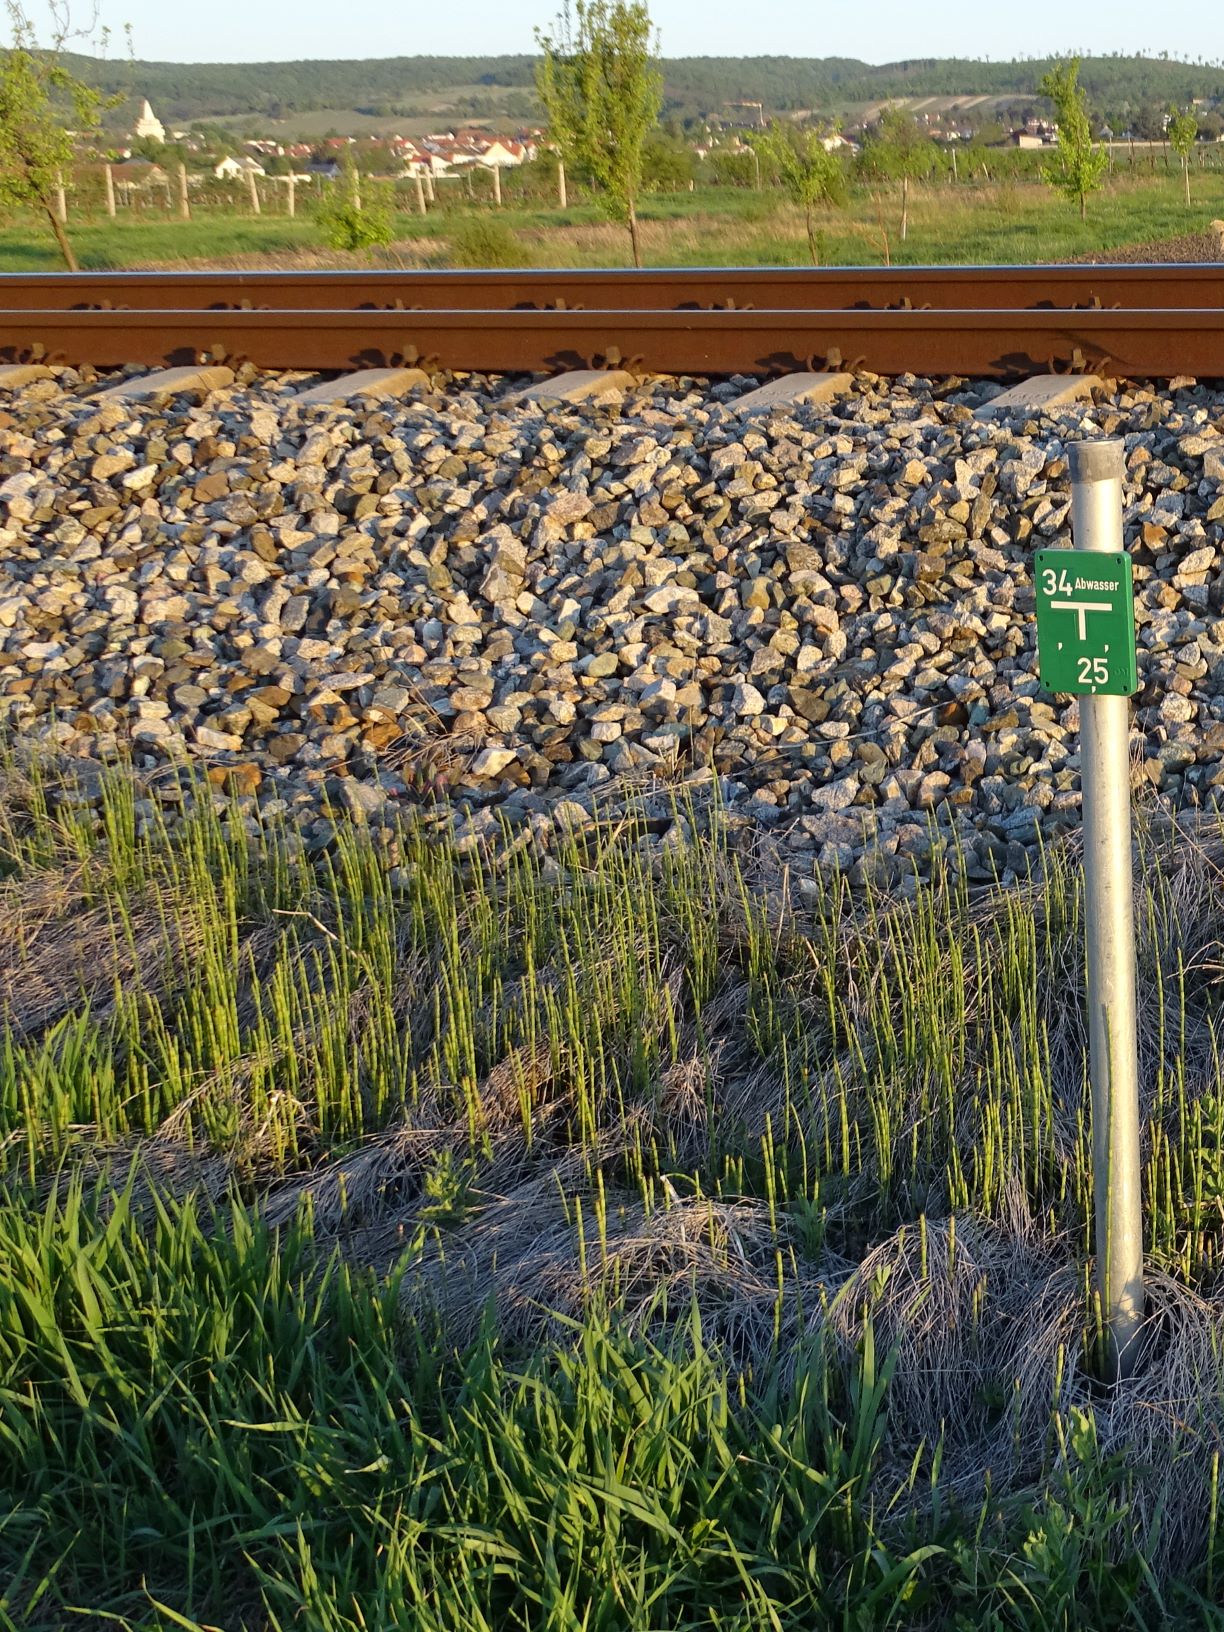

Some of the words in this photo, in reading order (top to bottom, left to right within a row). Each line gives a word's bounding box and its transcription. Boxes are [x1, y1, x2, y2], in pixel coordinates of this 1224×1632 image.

[1042, 568, 1073, 597] 34
[1074, 577, 1119, 591] Abwasser
[1077, 657, 1109, 685] 25
